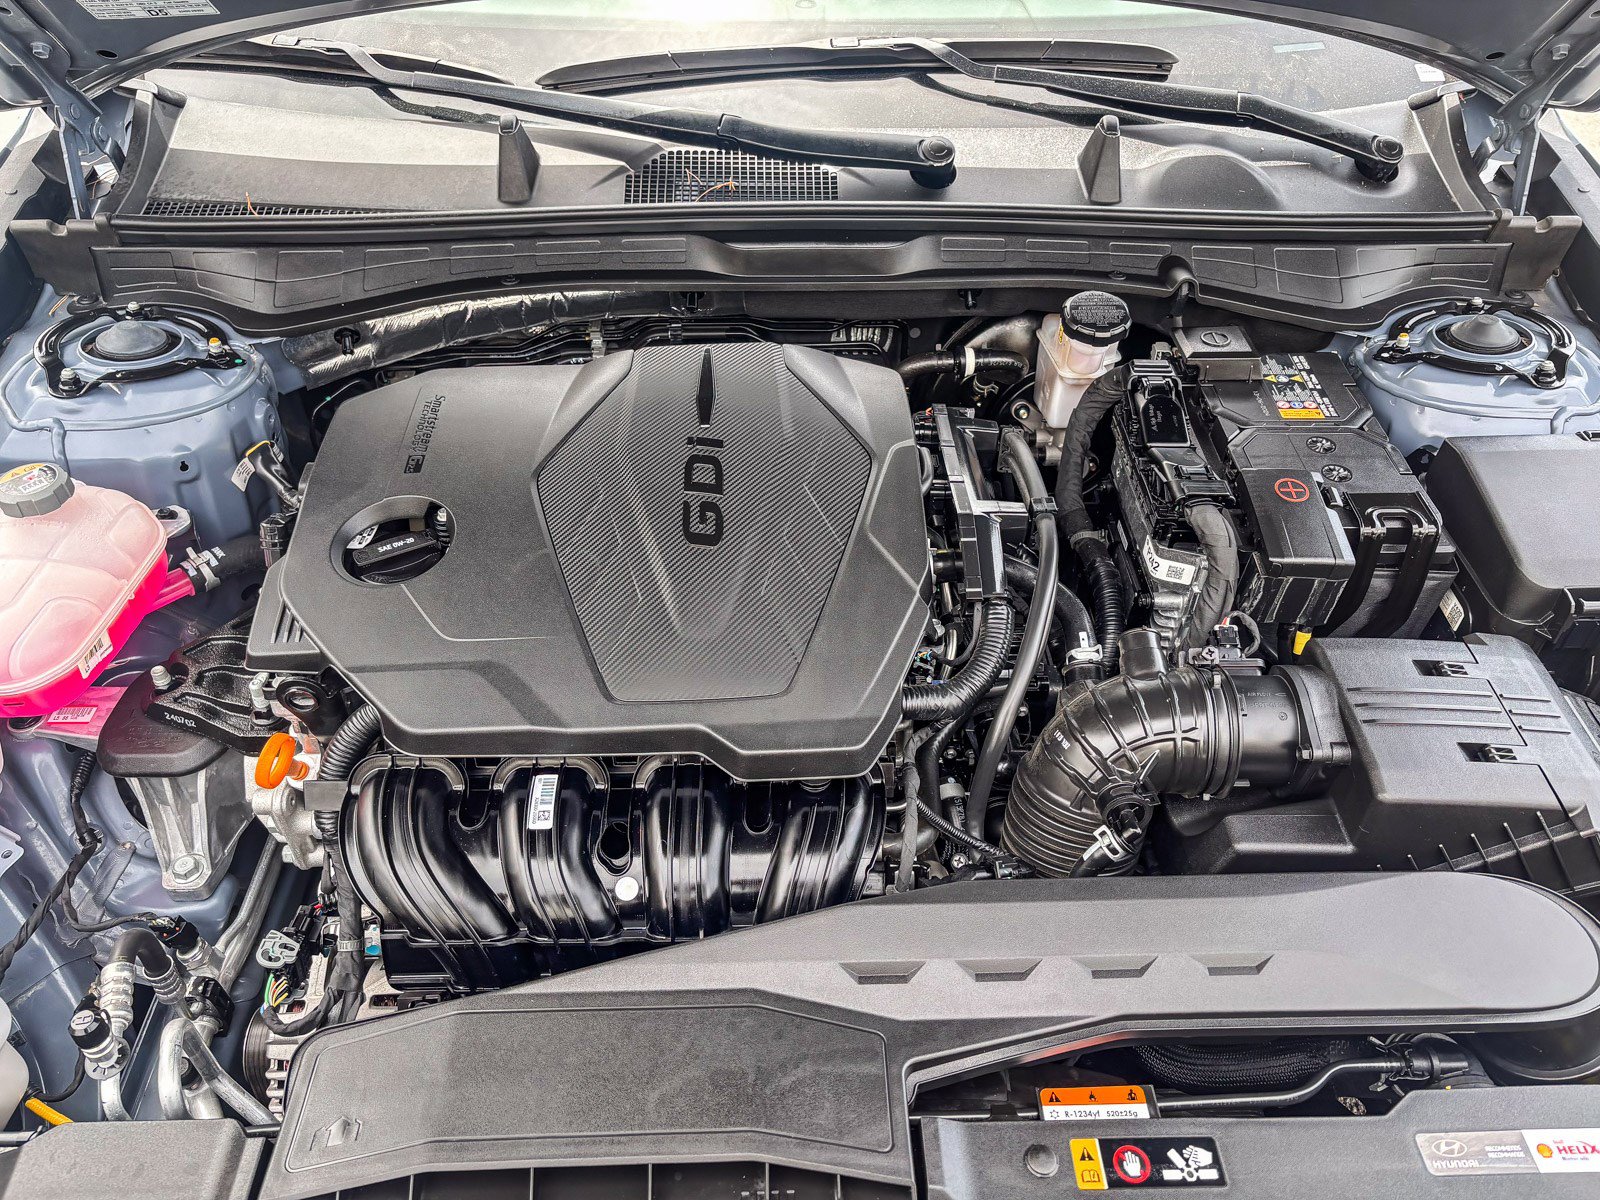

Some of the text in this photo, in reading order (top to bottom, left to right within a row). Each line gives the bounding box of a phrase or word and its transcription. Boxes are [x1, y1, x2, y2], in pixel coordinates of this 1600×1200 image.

[409, 400, 433, 453] TECHNOLOGY
[419, 394, 446, 453] Smartstream
[682, 436, 724, 547] GDi
[377, 537, 415, 553] SAE 0W-20
[164, 711, 197, 728] 240702
[1064, 1110, 1138, 1120] R-1234yf 520±25g
[1557, 1145, 1600, 1155] HELIX
[1432, 1159, 1480, 1169] HYUNDAI
